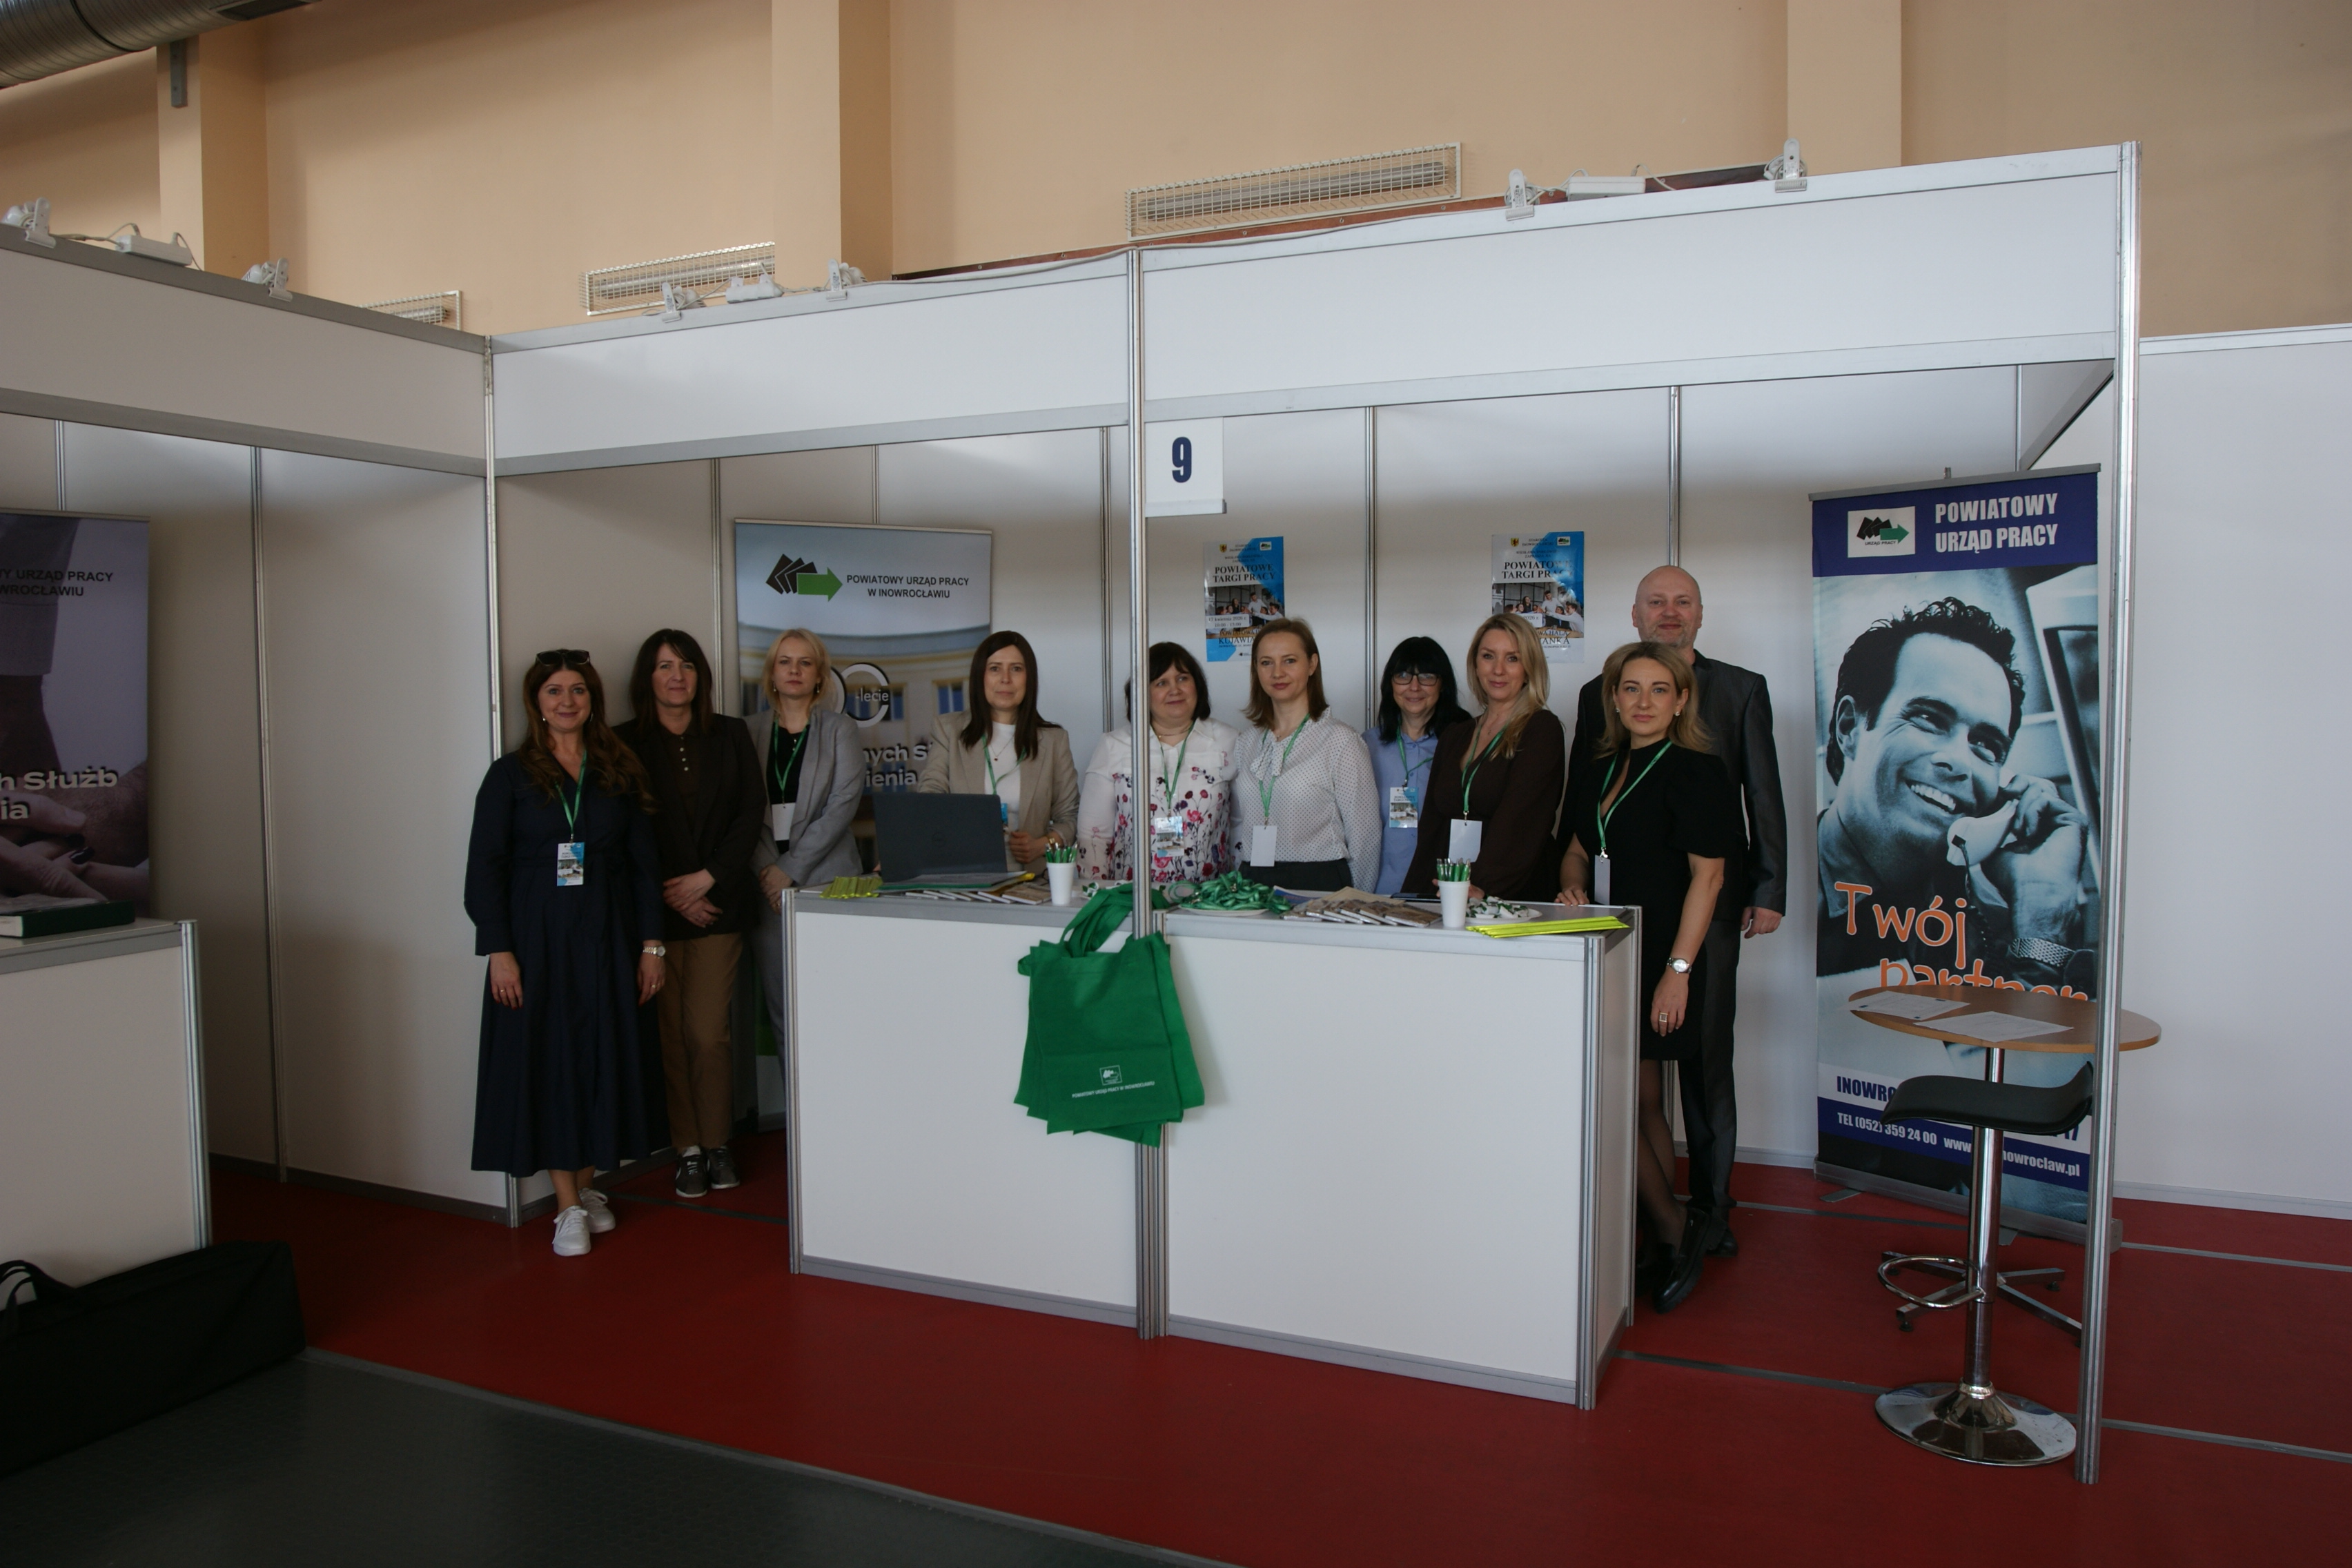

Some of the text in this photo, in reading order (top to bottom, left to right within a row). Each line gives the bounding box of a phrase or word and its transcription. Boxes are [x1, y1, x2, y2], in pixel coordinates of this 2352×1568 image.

[1172, 436, 1192, 483] 9
[1935, 493, 2058, 523] POWIATOWY
[1935, 524, 2058, 553] URZĄD PRACY
[17, 570, 63, 582] URZĄD
[68, 571, 113, 582] PRACY
[1213, 572, 1275, 582] TARGI PRACY
[1215, 564, 1273, 574] POWIATOWE
[1502, 570, 1534, 579] TARGI
[846, 575, 970, 587] POWIATOWY URZĄD PRACY
[0, 585, 84, 596] WROCŁAWIU
[879, 589, 950, 598] INOWROCŁAWIU
[23, 768, 118, 790] Służb
[1834, 881, 1967, 970] Twój
[1836, 1076, 1897, 1102] INOWRO
[1837, 1112, 1854, 1126] TEL
[1855, 1116, 1883, 1133] (052)
[1885, 1124, 1905, 1138] 359
[1908, 1128, 1921, 1141] 24
[1923, 1131, 1937, 1146] 00
